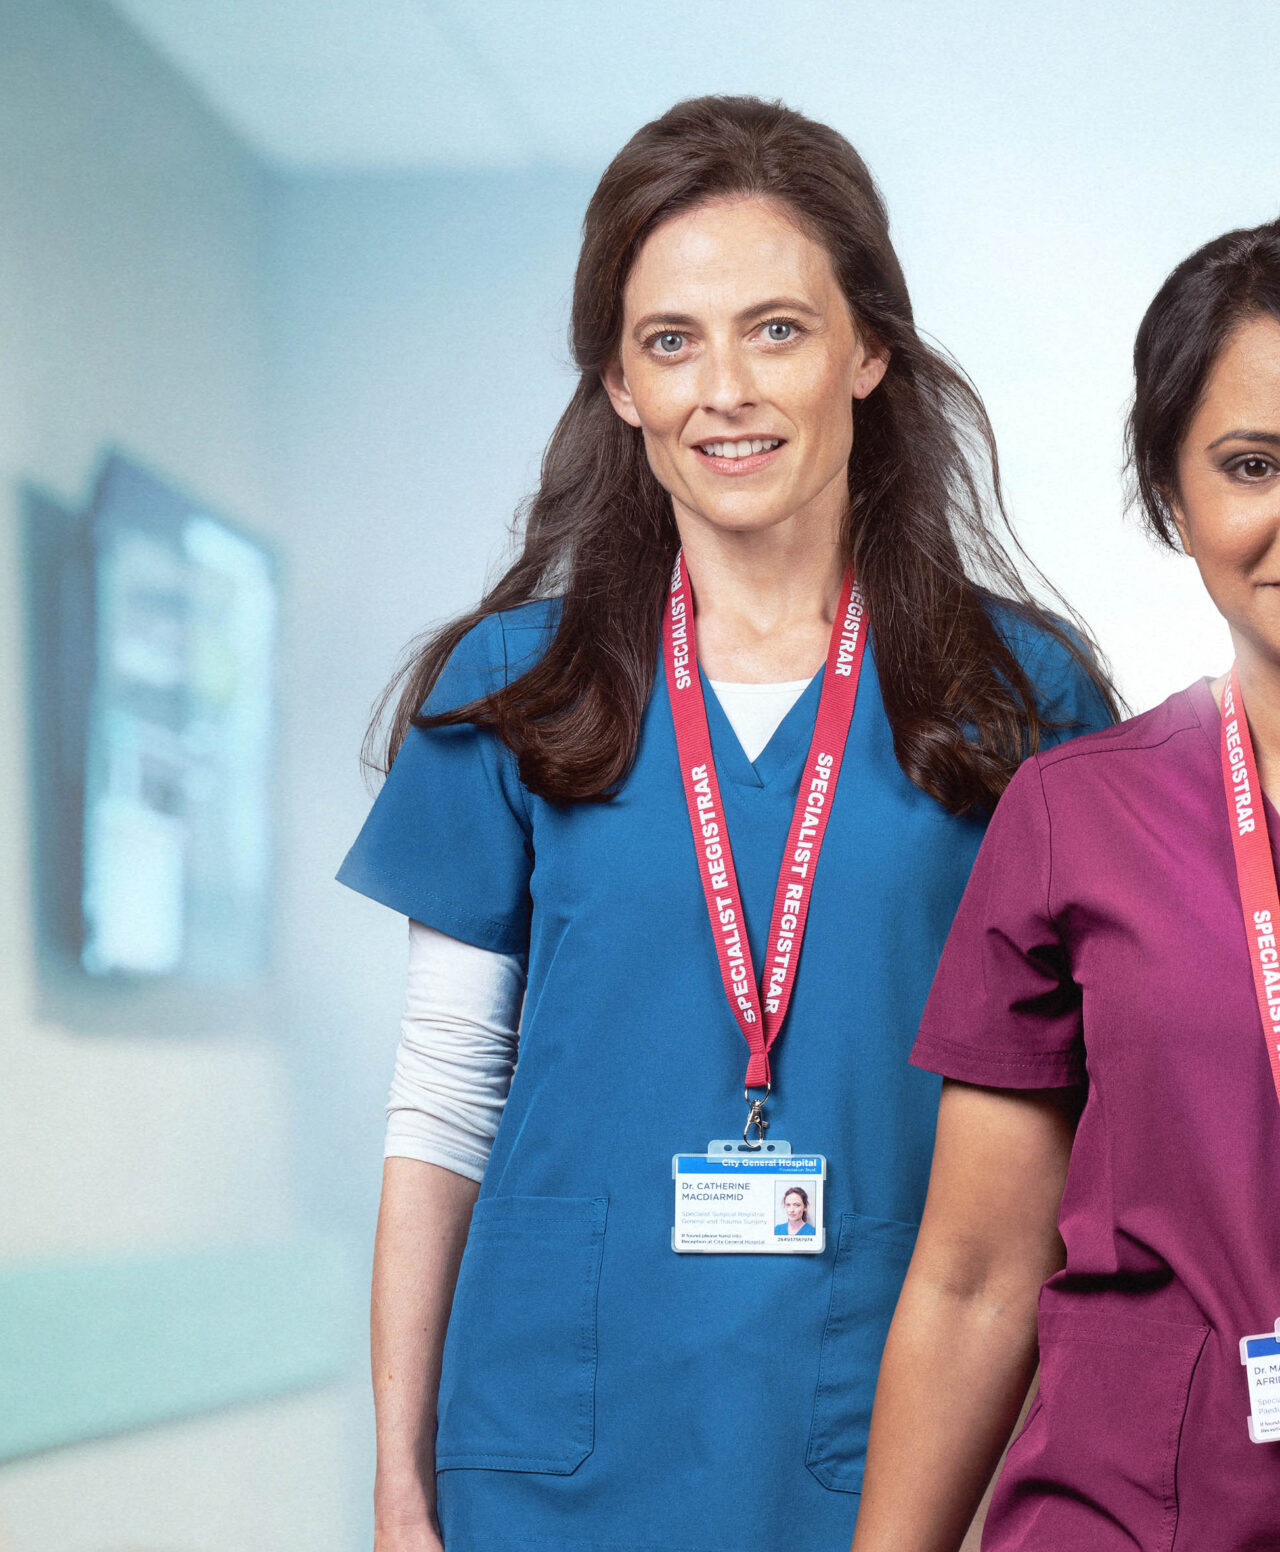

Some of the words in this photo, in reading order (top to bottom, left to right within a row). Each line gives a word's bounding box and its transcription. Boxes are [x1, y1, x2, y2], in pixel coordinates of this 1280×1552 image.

[671, 593, 692, 690] SPECIALIST
[691, 763, 729, 890] REGISTRAR
[791, 752, 834, 879] SPECIALIST
[1225, 719, 1256, 836] REGISTRAR
[715, 896, 757, 1024] SPECIALIST
[764, 883, 804, 1014] REGISTRAR
[681, 1193, 744, 1201] MACDIARMID
[682, 1182, 695, 1190] Dr.
[697, 1182, 751, 1190] CATHERINE
[722, 1158, 740, 1168] City
[742, 1158, 777, 1167] General
[779, 1158, 817, 1168] Hospital
[1254, 1366, 1267, 1375] Dr.
